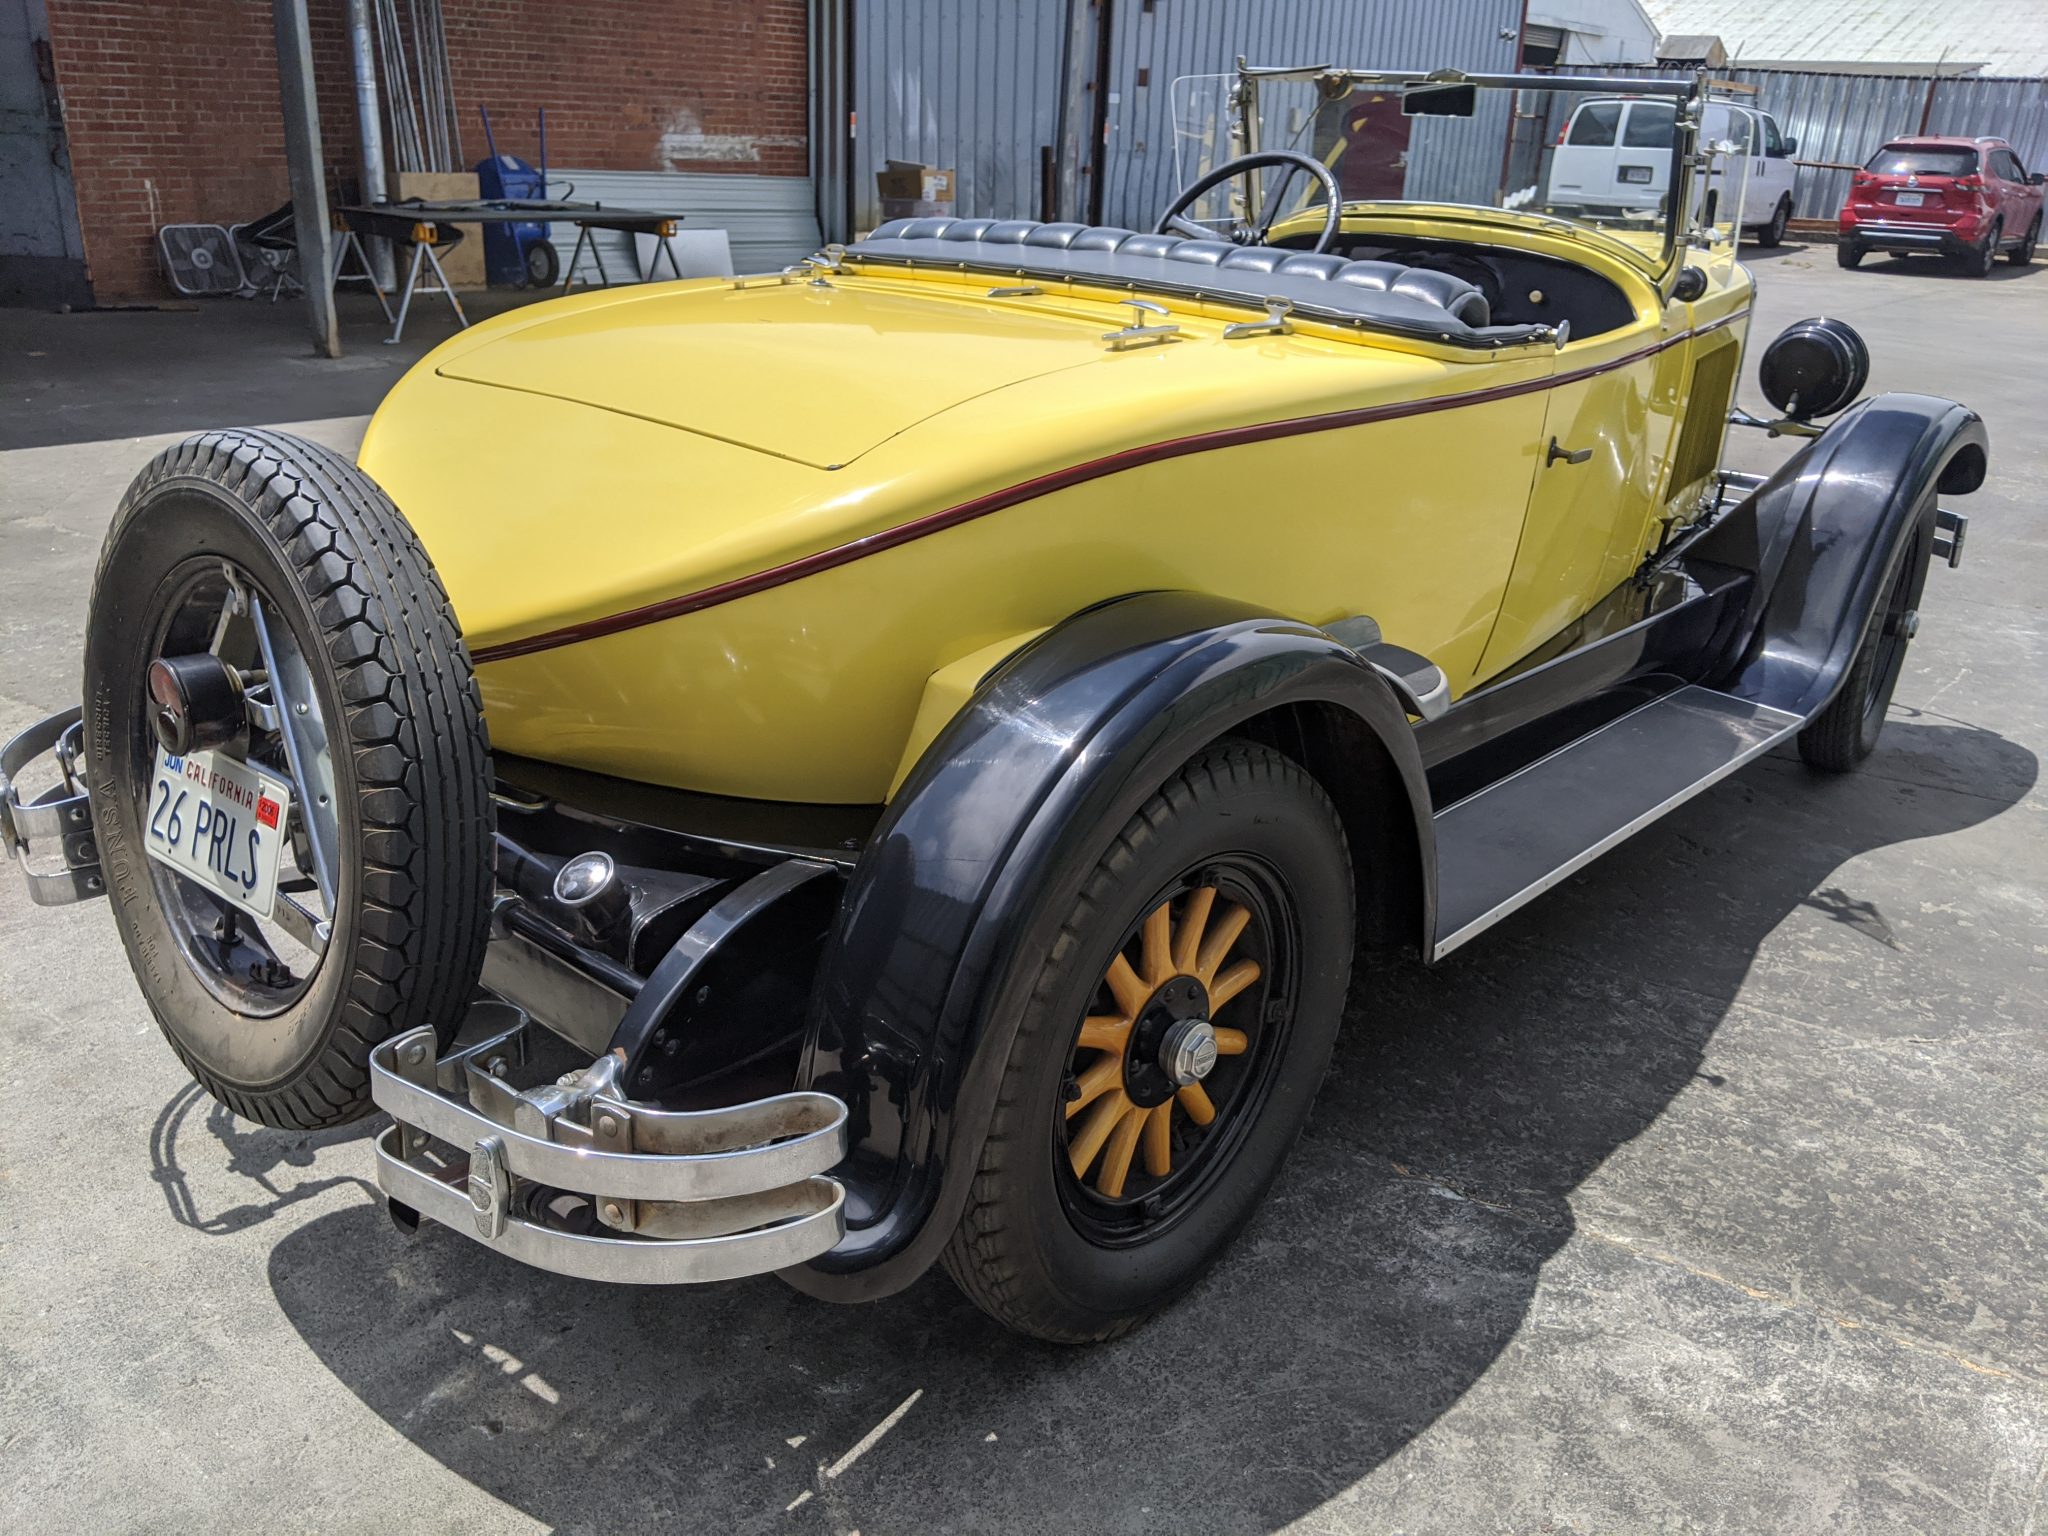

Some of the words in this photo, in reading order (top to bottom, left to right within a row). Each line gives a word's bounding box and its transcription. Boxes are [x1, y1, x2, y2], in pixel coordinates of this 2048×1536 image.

[186, 760, 254, 810] CALIFORNIA
[150, 779, 188, 846] 26
[191, 799, 260, 890] PRLS
